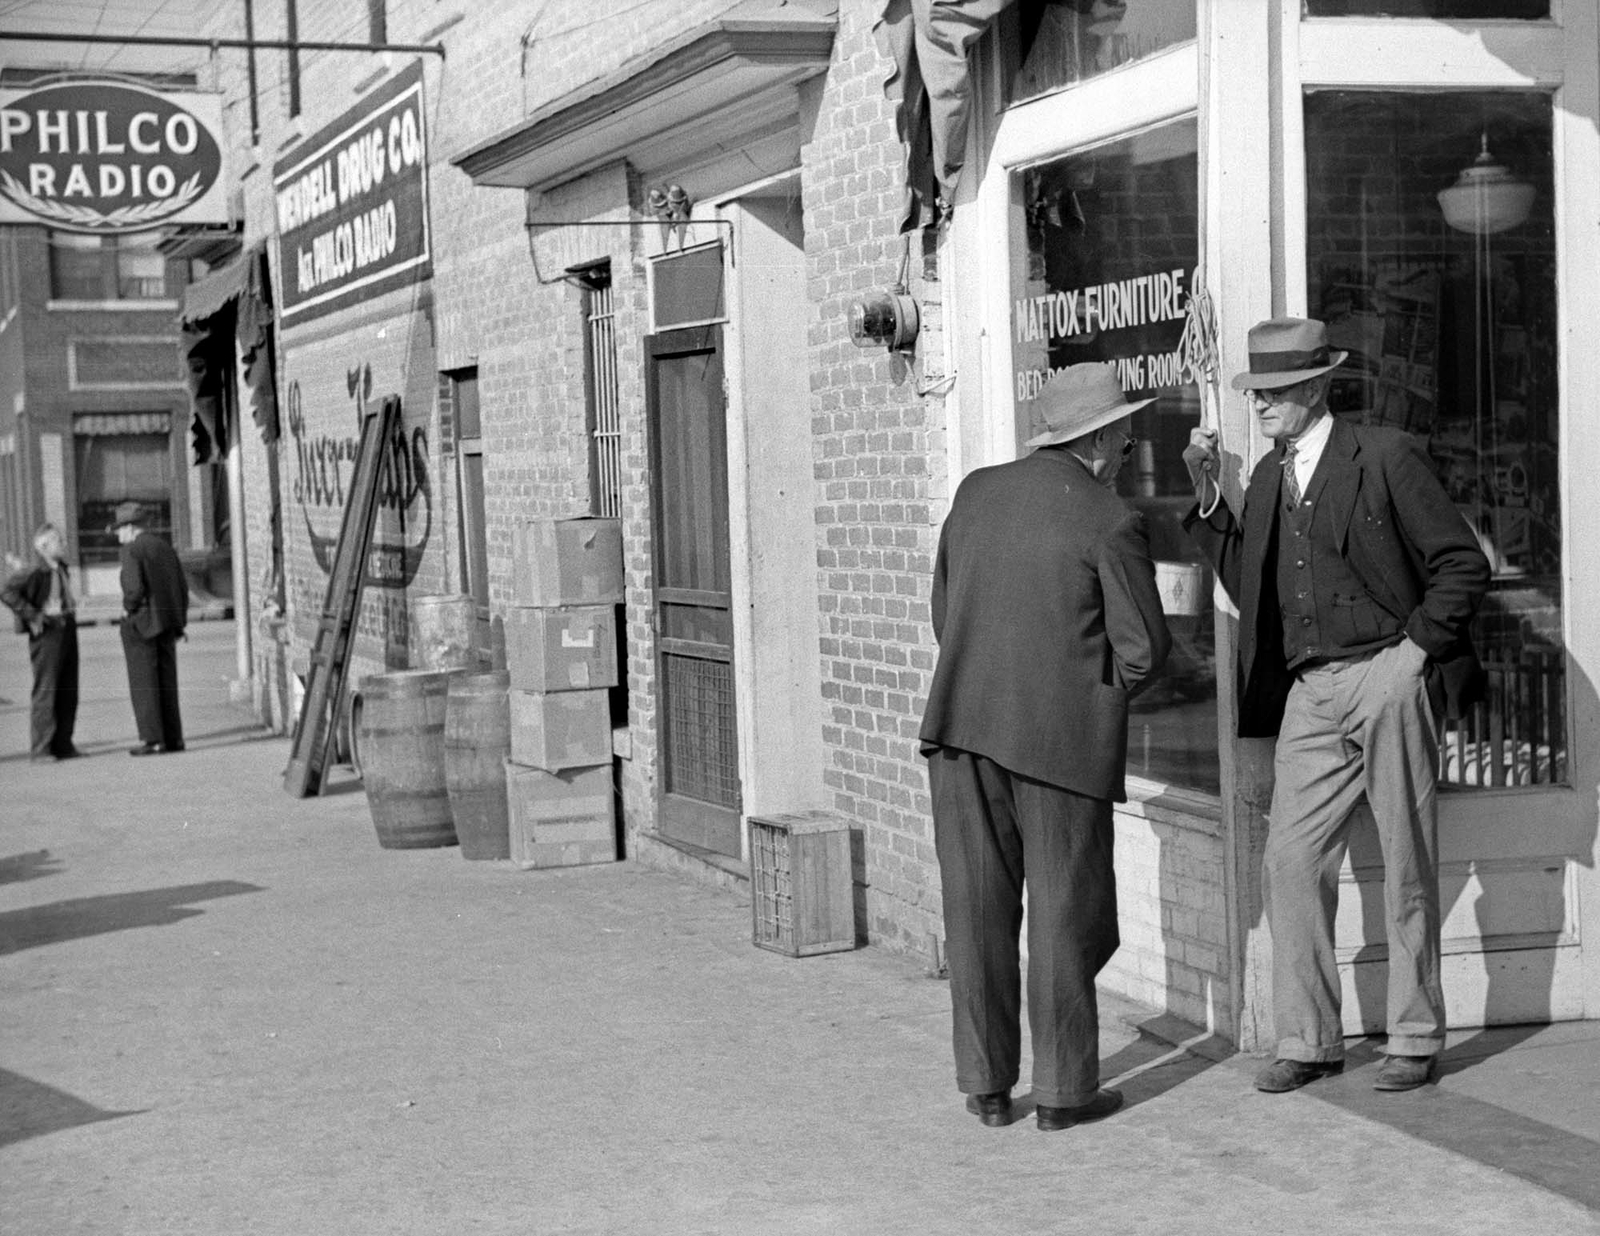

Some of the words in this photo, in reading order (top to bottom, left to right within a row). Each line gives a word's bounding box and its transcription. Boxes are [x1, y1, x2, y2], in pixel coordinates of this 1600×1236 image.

[0, 108, 198, 155] PHILCO
[29, 162, 177, 198] RADIO
[337, 126, 385, 205] DRUG
[313, 221, 354, 284] PHILCO
[354, 198, 397, 269] RADIO
[1015, 288, 1081, 344] MATTOX
[1084, 268, 1186, 334] FURNITURE
[1017, 369, 1043, 402] BED
